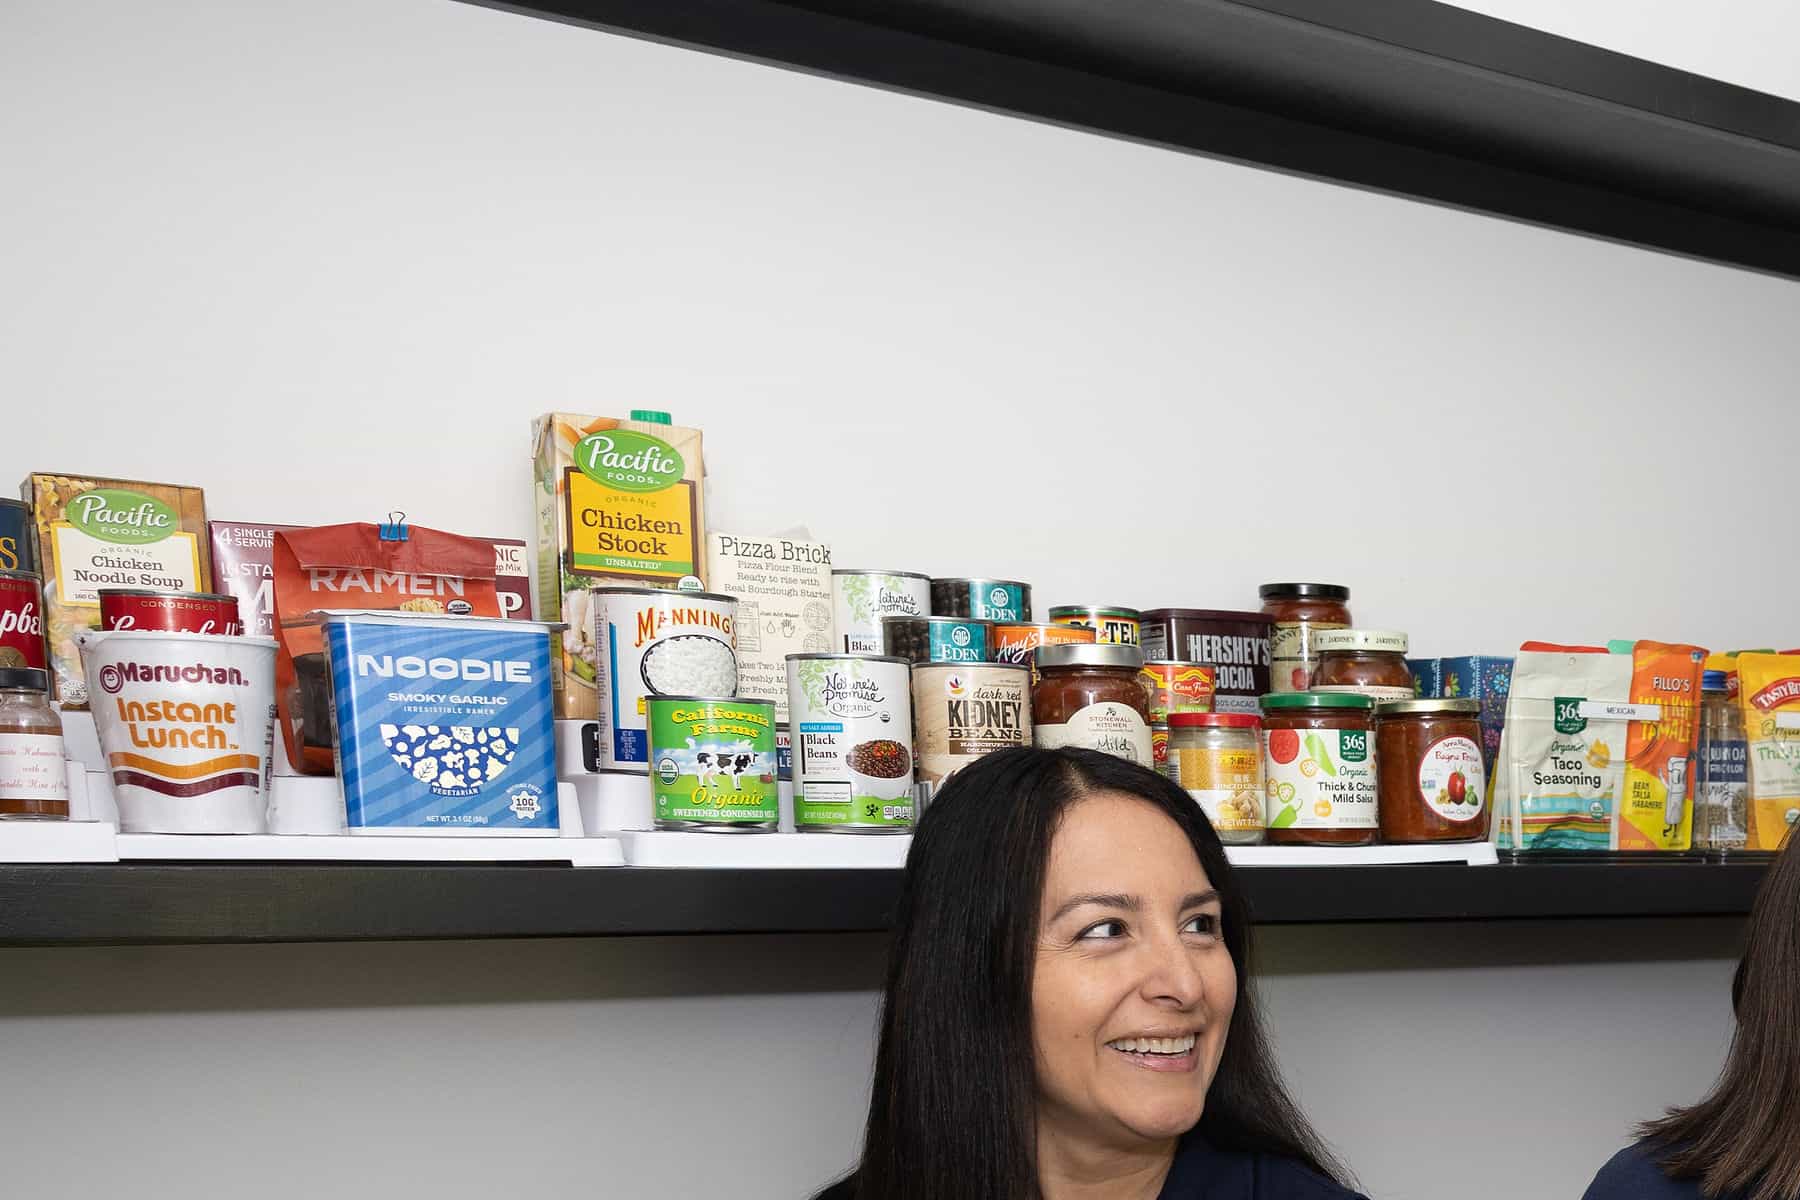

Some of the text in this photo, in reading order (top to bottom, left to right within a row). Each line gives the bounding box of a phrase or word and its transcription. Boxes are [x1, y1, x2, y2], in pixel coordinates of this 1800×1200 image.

[584, 435, 676, 474] Pacific
[607, 472, 654, 484] FOODS
[605, 496, 657, 508] ORGANIC
[75, 495, 170, 529] Pacific
[581, 508, 683, 536] Chicken
[101, 526, 147, 537] FOODS
[219, 527, 274, 545] 4 SINGLE
[598, 531, 668, 556] Stock
[719, 536, 831, 565] Pizza Brick
[100, 548, 152, 557] ORGANIC
[91, 555, 164, 571] Chicken
[738, 560, 818, 575] Pizza Flour Blend
[73, 569, 184, 590] Noodle Soup
[309, 567, 464, 597] RAMEN
[737, 572, 820, 587] Ready to rise with
[724, 583, 797, 599] Real Sourdough
[140, 601, 217, 611] CONDENSED
[982, 605, 1016, 622] EDEN
[942, 643, 979, 661] EDEN
[995, 632, 1039, 664] Amy's
[1189, 634, 1271, 666] HERSHEY'S
[358, 655, 532, 684] NOODIE
[740, 675, 773, 683] Freshly
[1215, 666, 1255, 690] COCOA
[1653, 676, 1691, 692] FILLO'S
[388, 693, 508, 706] SMOKY GARLIC
[973, 687, 1022, 700] dark red
[1758, 685, 1788, 708] TASTY
[117, 697, 236, 724] Instant
[403, 706, 462, 714] IRRESISTIBLE
[672, 707, 768, 727] California
[948, 700, 1022, 729] KIDNEY
[1606, 707, 1636, 715] MEXICAN
[128, 723, 228, 749] Lunch
[691, 724, 760, 738] Farms
[949, 729, 1023, 739] BEANS
[806, 734, 836, 745] Black
[1097, 735, 1130, 752] Mild
[1342, 734, 1366, 750] 365
[806, 748, 838, 760] Beans
[1551, 756, 1582, 770] Taco
[1339, 766, 1369, 779] Organic
[1533, 772, 1602, 789] Seasoning
[432, 787, 479, 796] VEGETARIAN
[1318, 782, 1354, 792] Thick &
[1633, 791, 1650, 799] SALSA
[690, 789, 764, 809] Organic
[1333, 793, 1373, 804] Mild Salsa
[1632, 800, 1663, 809] HABANERO
